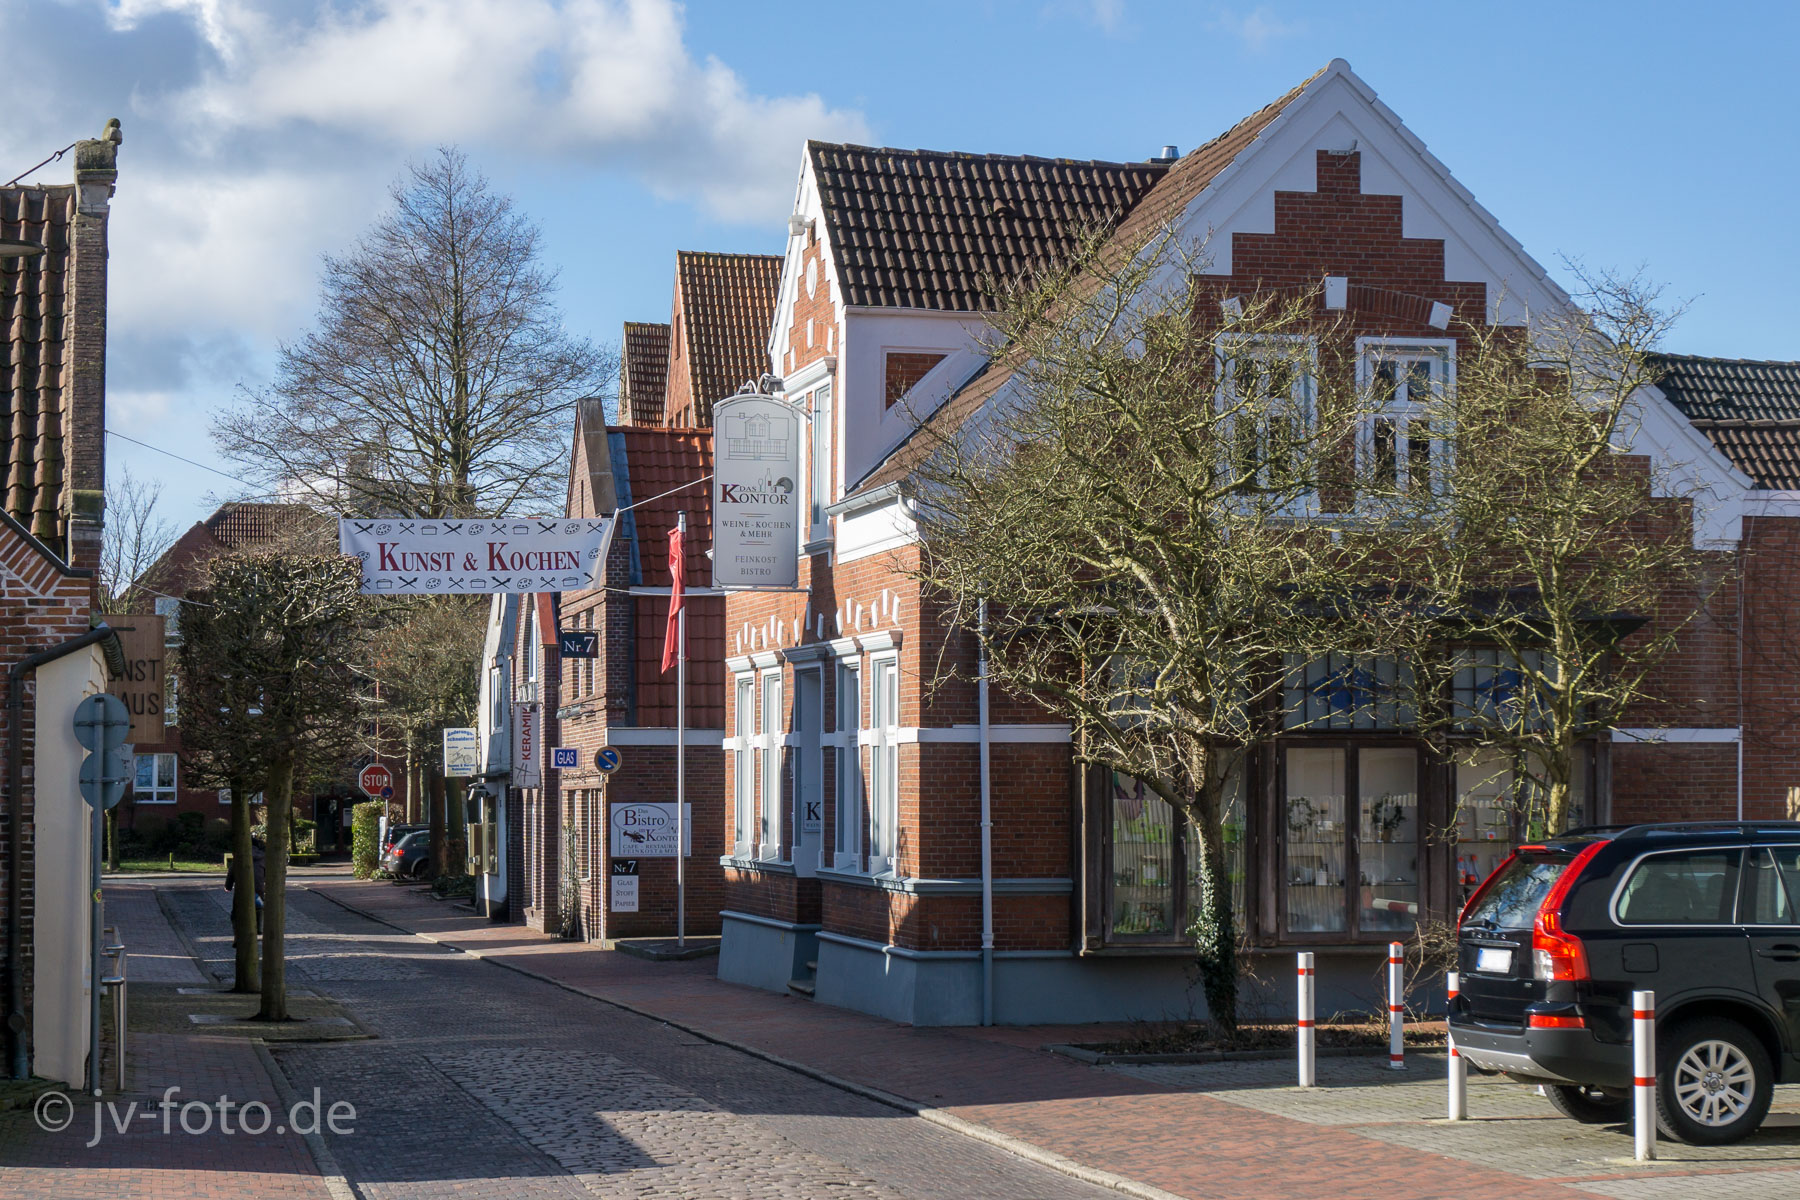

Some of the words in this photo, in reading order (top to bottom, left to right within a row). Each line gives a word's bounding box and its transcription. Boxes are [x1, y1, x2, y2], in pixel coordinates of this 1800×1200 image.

[720, 483, 789, 505] KONTOR
[722, 520, 750, 528] WEINE
[755, 521, 791, 529] KOCHEN
[740, 530, 746, 538] &
[748, 530, 773, 538] MEHR
[377, 542, 455, 572] KUNST
[463, 554, 479, 571] &
[487, 541, 581, 572] KOCHEN
[735, 555, 777, 564] FEINKOST
[740, 568, 772, 576] BISTRO
[557, 751, 575, 765] GLAS
[364, 774, 389, 787] STOP
[623, 809, 665, 826] Bistro
[806, 801, 821, 821] K
[645, 828, 679, 842] KONTO
